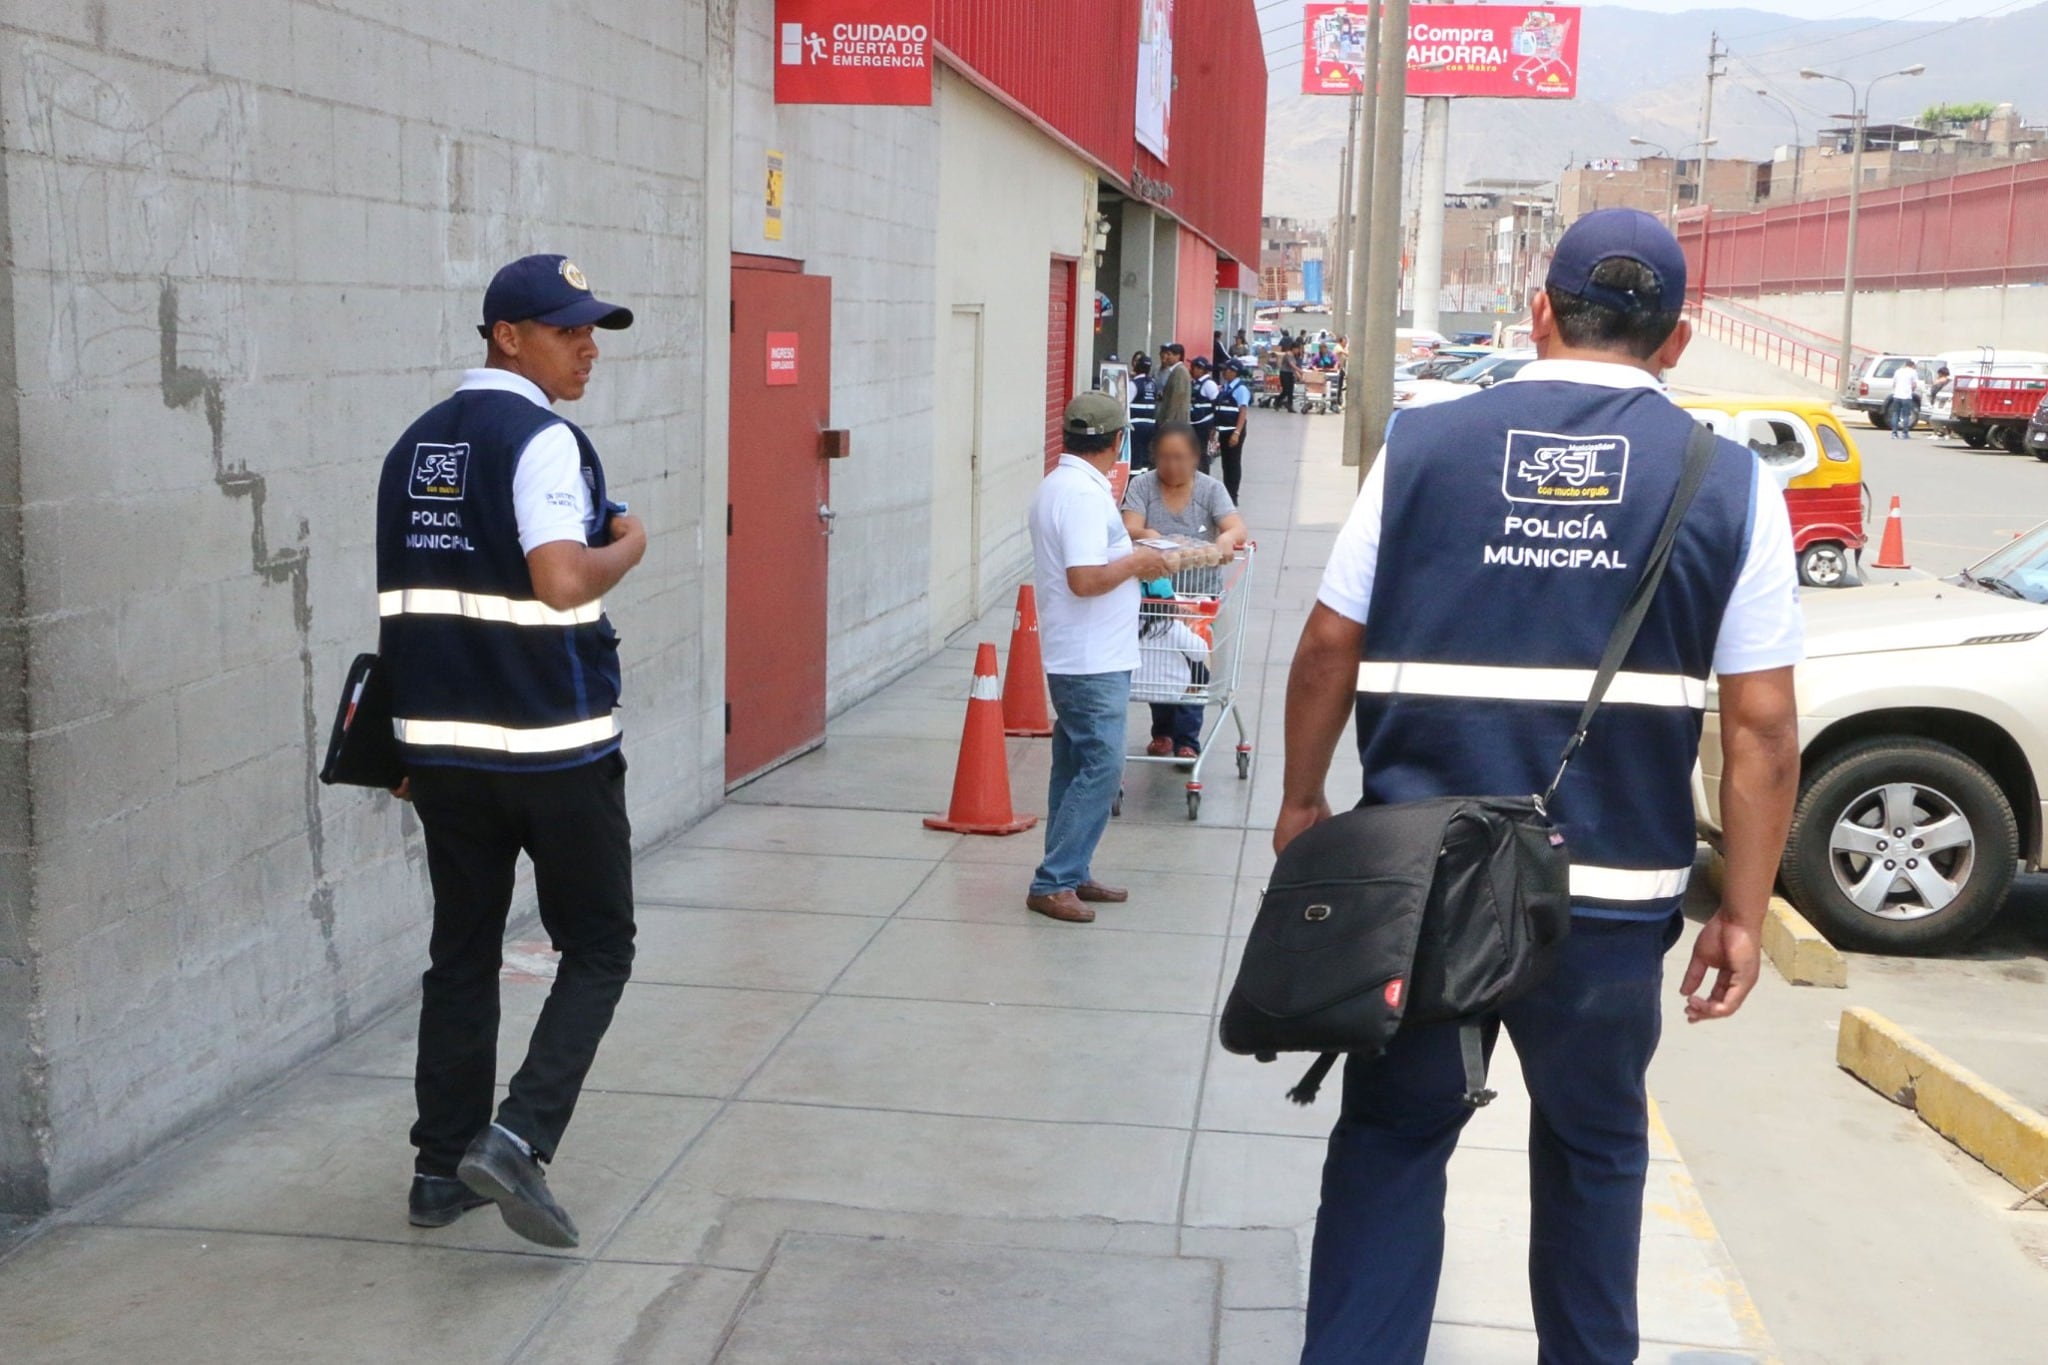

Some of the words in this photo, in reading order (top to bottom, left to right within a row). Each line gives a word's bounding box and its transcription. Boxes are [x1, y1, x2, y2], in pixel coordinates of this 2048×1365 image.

[833, 23, 928, 42] CUIDADO
[833, 42, 897, 54] PUERTA
[902, 43, 924, 56] DE
[1406, 45, 1508, 64] AHORRA!
[832, 55, 925, 67] EMERGENCIA
[1467, 63, 1497, 72] Makro
[1538, 486, 1553, 495] con
[1554, 487, 1580, 497] mucho
[1581, 486, 1609, 498] orgullo
[1505, 513, 1608, 539] POLICÍA
[1483, 545, 1627, 569] MUNICIPAL
